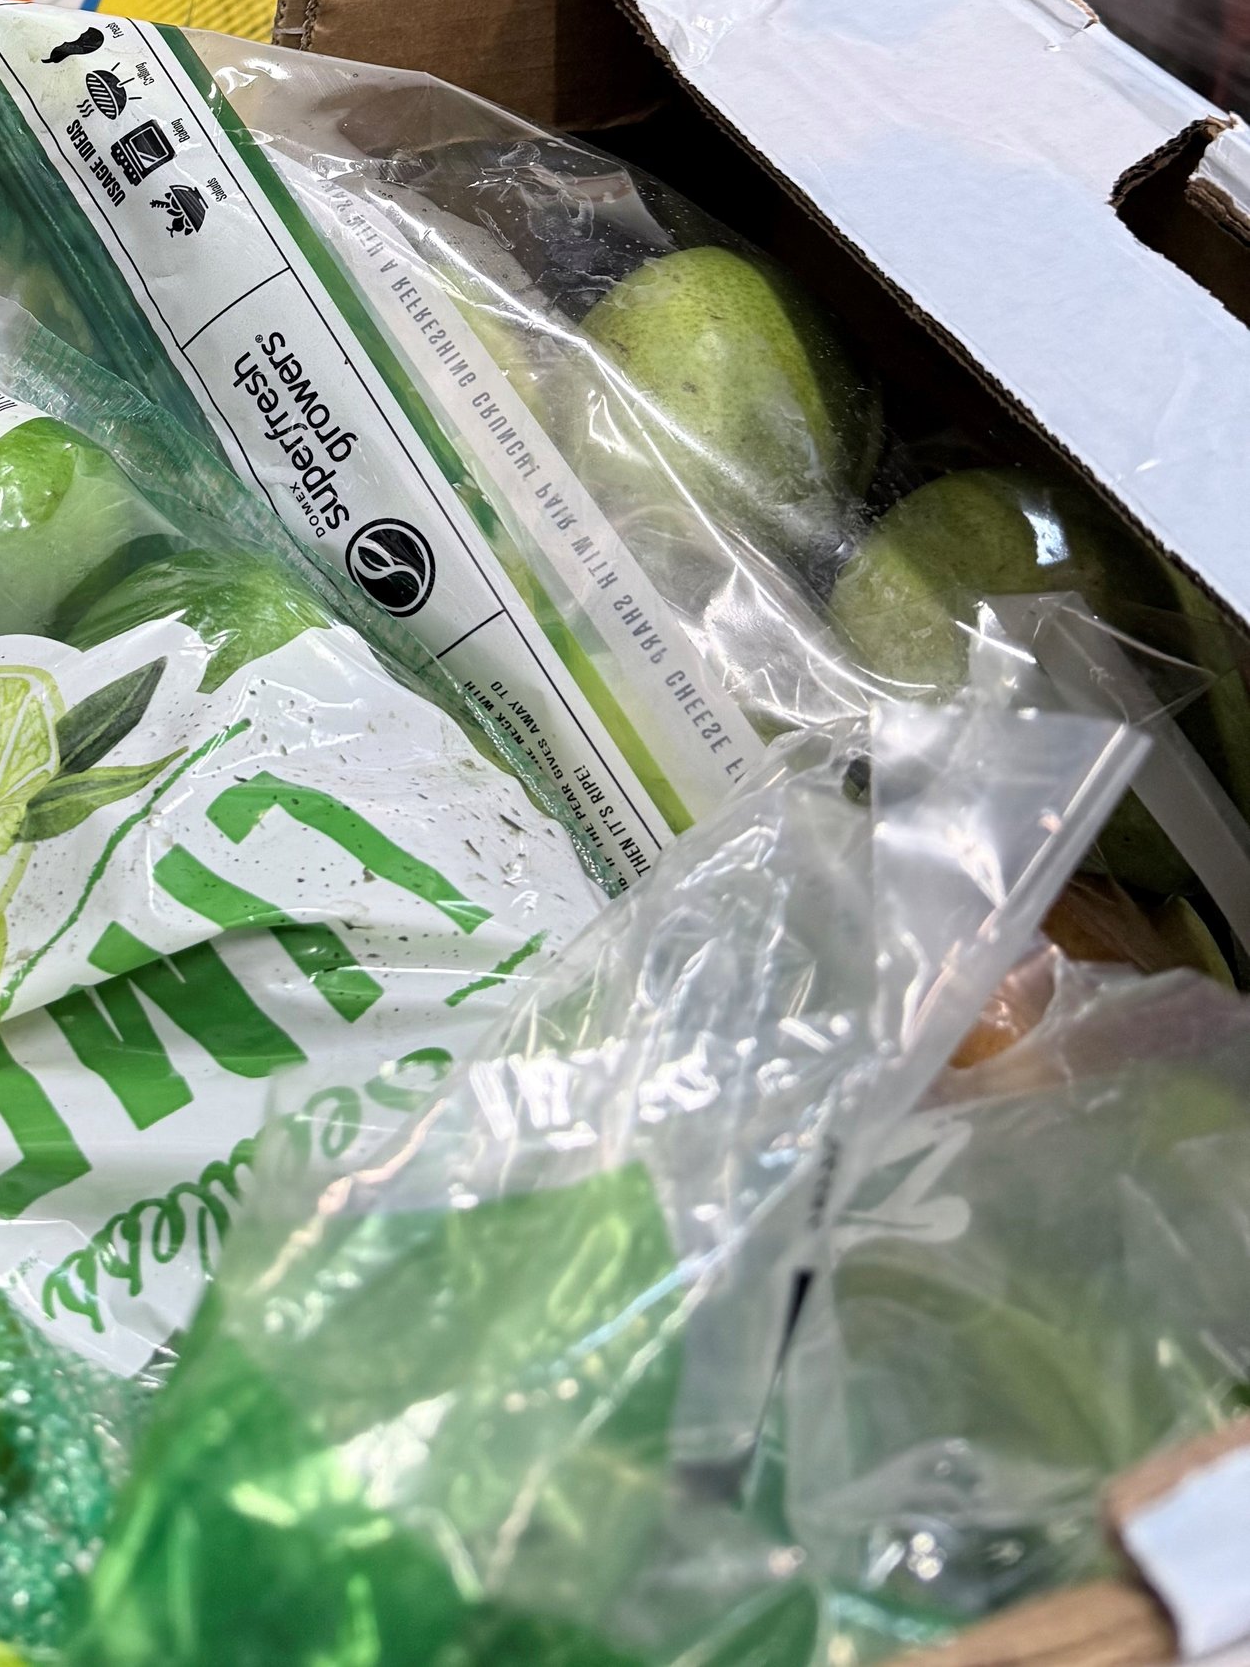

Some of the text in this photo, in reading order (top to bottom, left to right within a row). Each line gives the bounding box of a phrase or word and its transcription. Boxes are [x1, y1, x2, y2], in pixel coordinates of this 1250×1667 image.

[170, 117, 191, 144] Baking
[66, 119, 126, 208] USAGE IDEAS
[207, 176, 228, 203] Salads
[233, 351, 350, 531] superfresh
[289, 481, 327, 540] DOMEX
[490, 680, 509, 701] TO
[507, 700, 542, 734] AWAY
[537, 738, 565, 781] GIVES
[572, 764, 606, 805] RIPE!
[598, 805, 627, 838] IT'S
[618, 836, 652, 878] THEN
